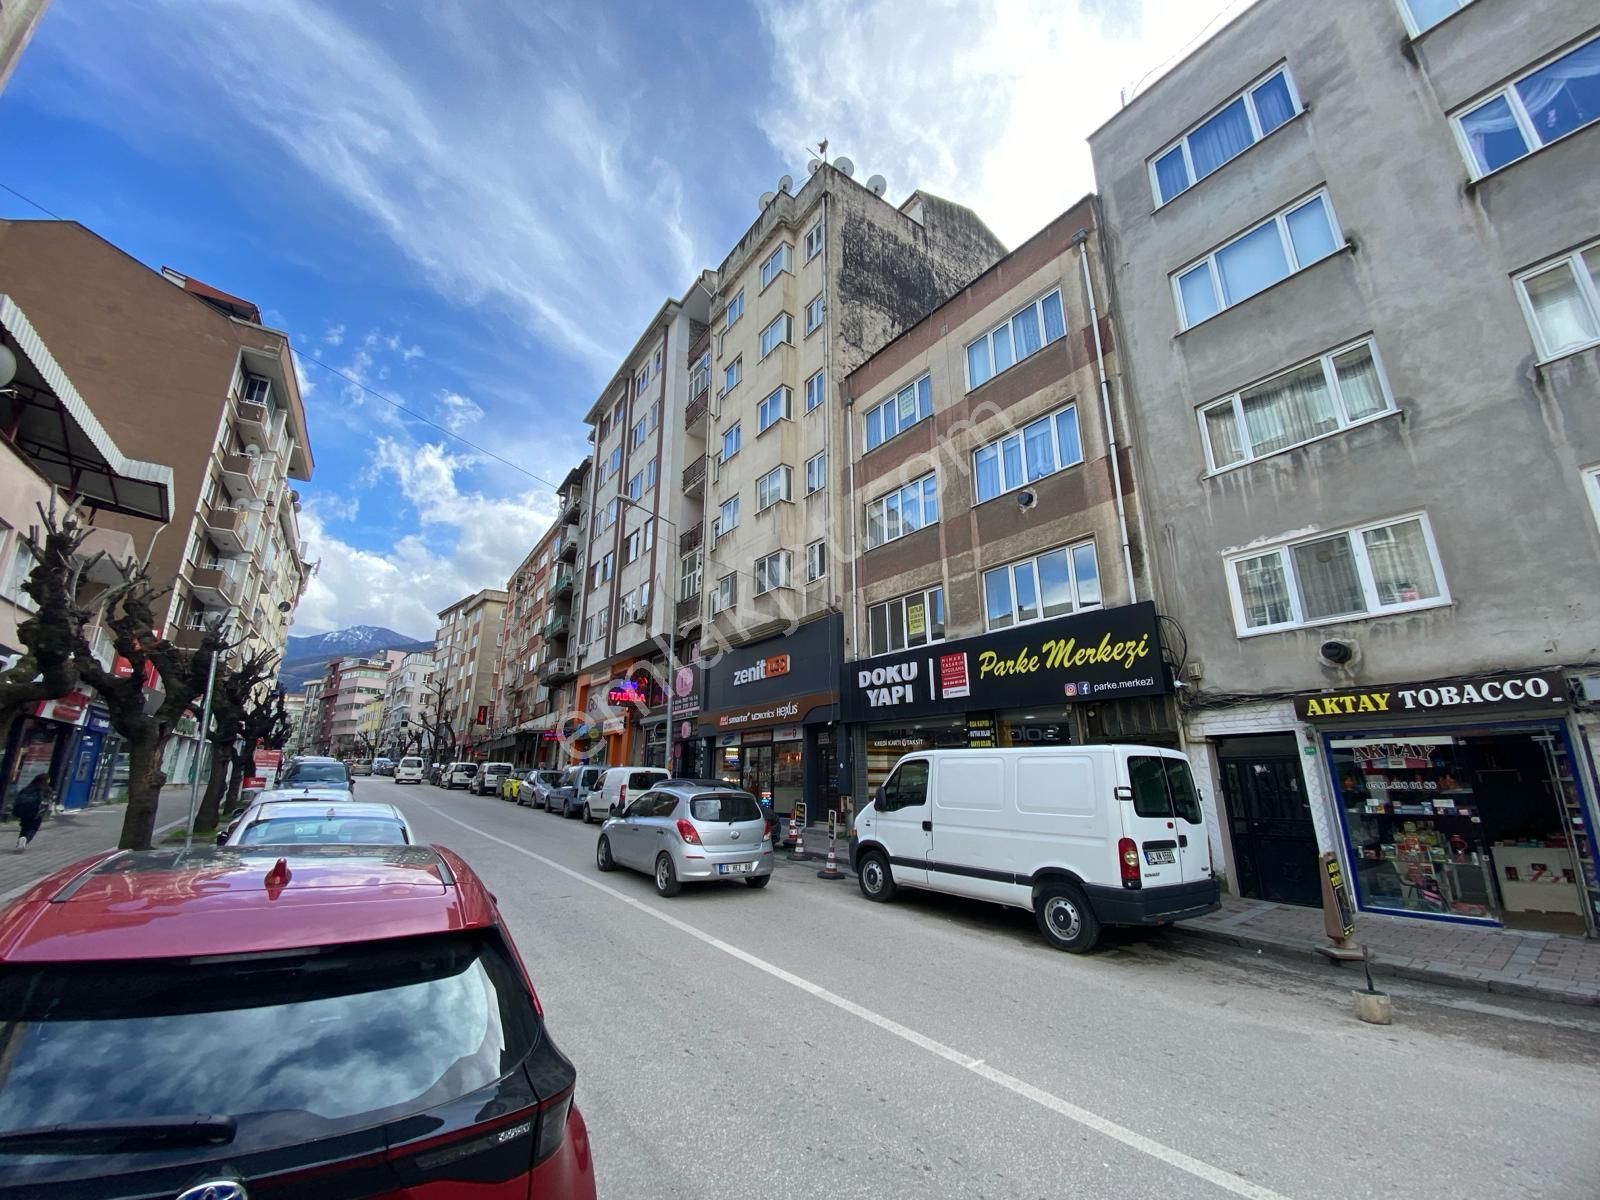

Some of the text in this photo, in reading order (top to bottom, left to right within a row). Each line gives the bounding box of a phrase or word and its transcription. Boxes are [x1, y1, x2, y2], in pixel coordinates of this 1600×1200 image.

[978, 632, 1149, 680] Parke Merkezi
[733, 659, 767, 686] zenit
[858, 661, 918, 689] DOKU
[1093, 677, 1154, 692] parke.merkezi
[866, 684, 914, 707] YAPI
[1306, 677, 1550, 716] AKTAY TOBACCO
[1352, 743, 1436, 764] AKTAY
